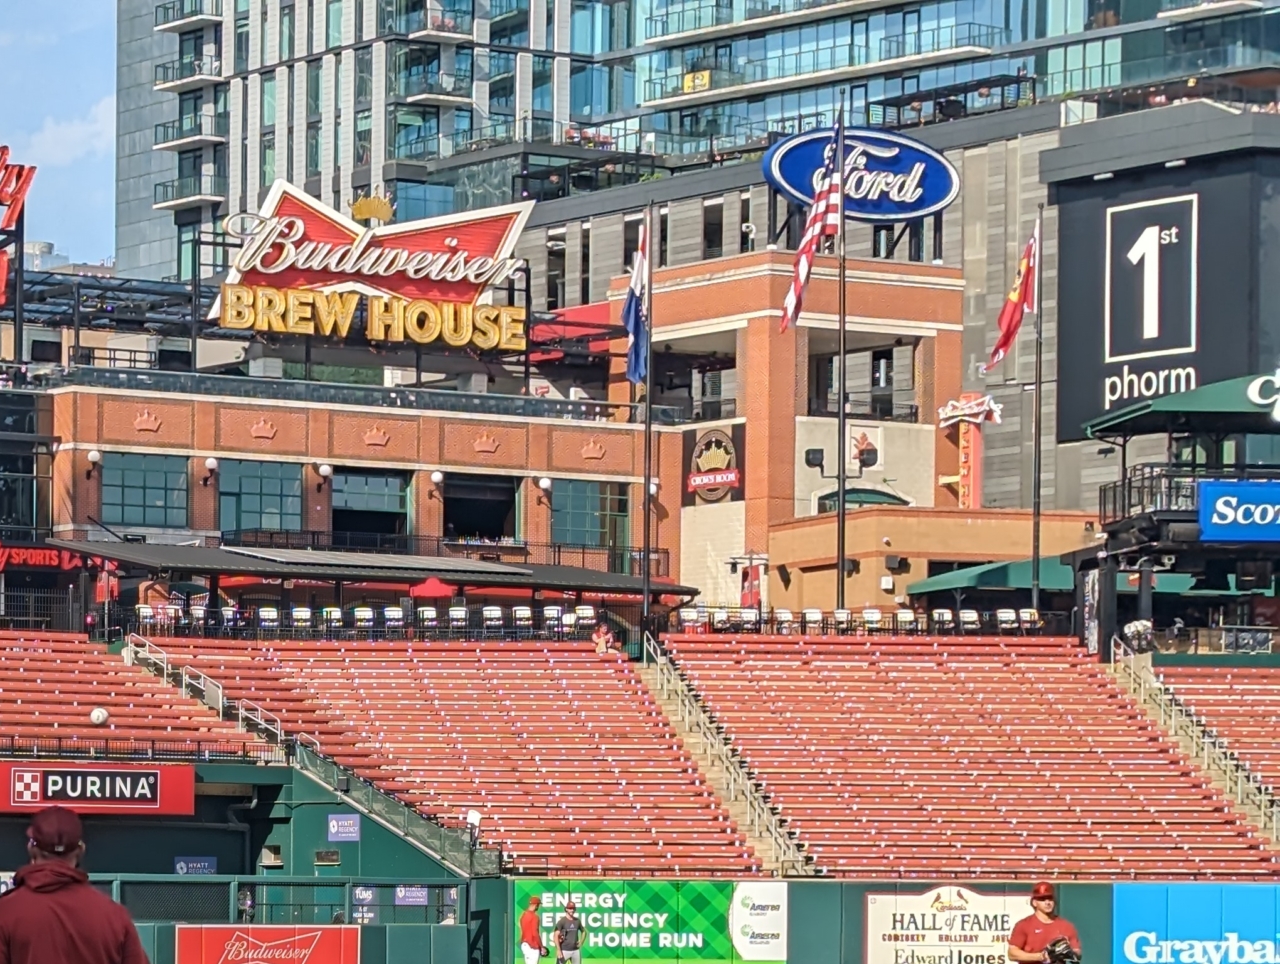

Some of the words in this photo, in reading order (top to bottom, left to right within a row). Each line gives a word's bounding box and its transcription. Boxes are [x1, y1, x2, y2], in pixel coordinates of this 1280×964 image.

[813, 140, 926, 203] Ford
[222, 212, 524, 284] Budweiser
[220, 283, 360, 337] BREW
[366, 294, 527, 350] HOUSE
[1105, 365, 1196, 410] phorm
[10, 548, 59, 566] SPORTS
[355, 890, 372, 899] TUMS
[541, 893, 627, 908] ENERGY
[541, 913, 669, 928] EICIENCY
[891, 913, 942, 931] HALL
[944, 914, 957, 931] of
[961, 914, 1010, 932] FAME
[589, 933, 656, 948] HOME
[660, 933, 702, 948] RUN
[938, 934, 979, 942] HOLLIDAY
[224, 939, 312, 960] Budweiser
[894, 949, 953, 964] Edward
